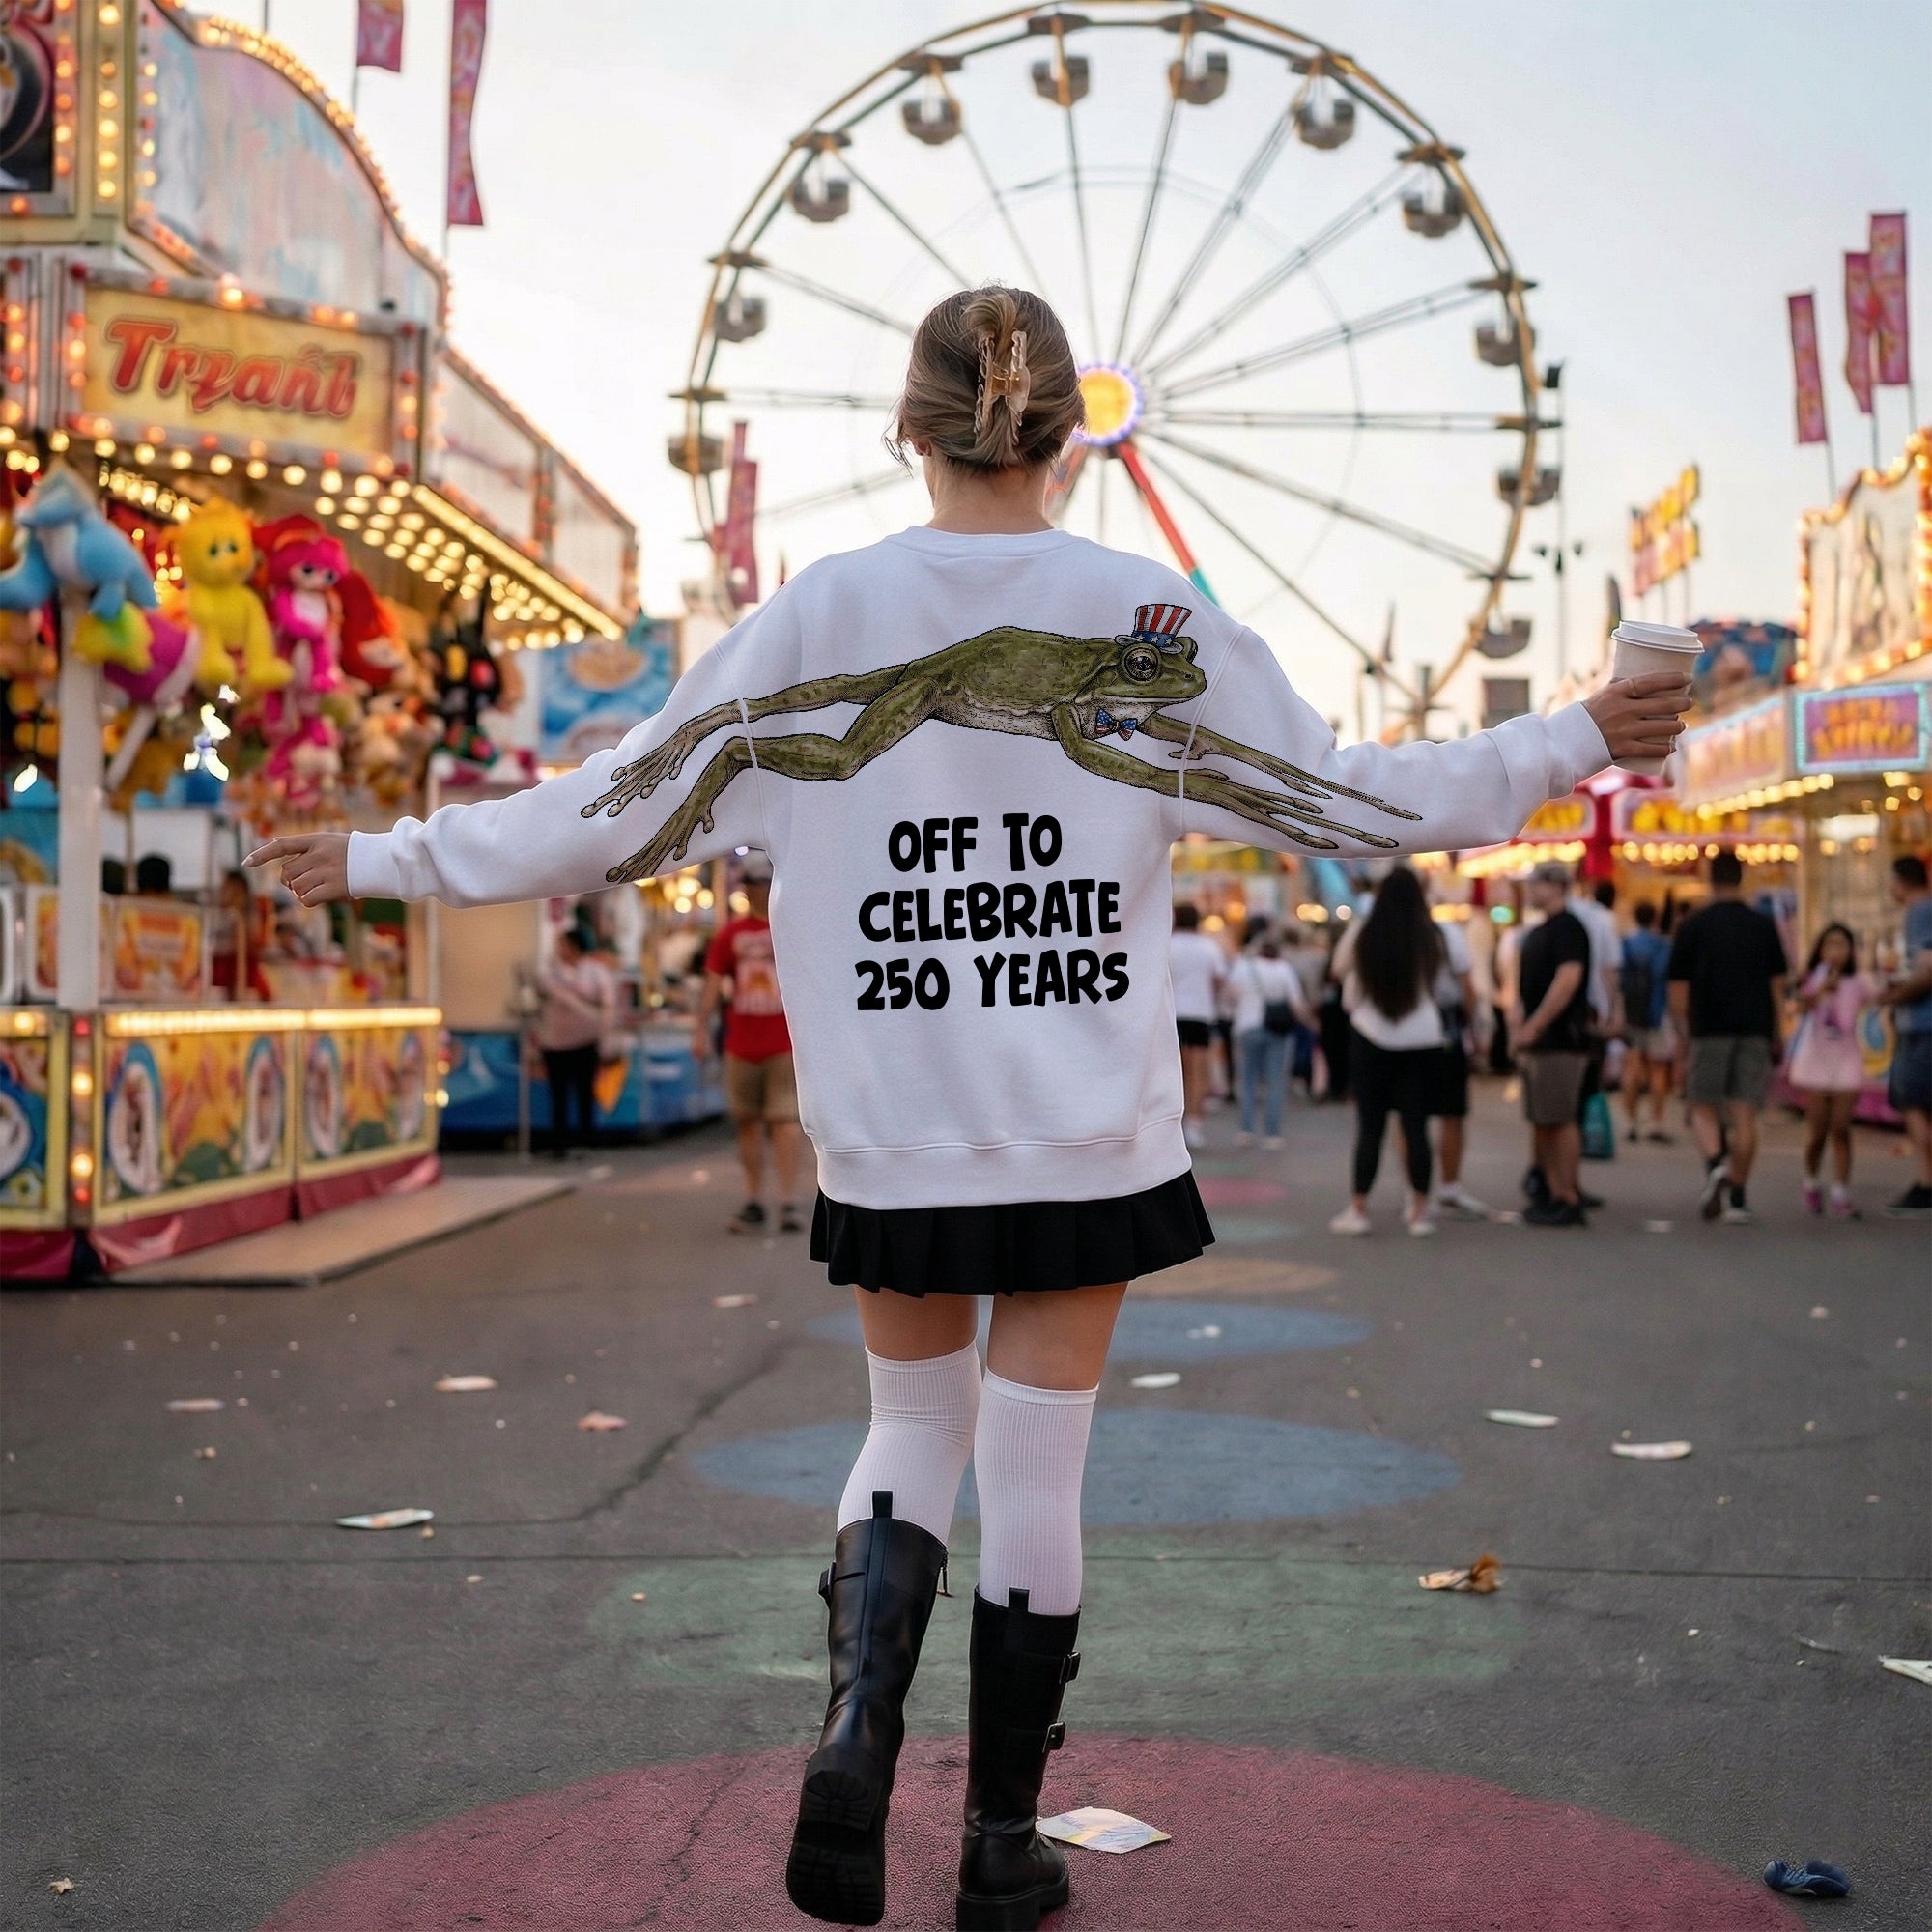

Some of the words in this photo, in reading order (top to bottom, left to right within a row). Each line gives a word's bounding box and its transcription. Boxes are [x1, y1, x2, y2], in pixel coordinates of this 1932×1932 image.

[888, 816, 979, 873] OFF
[1003, 813, 1063, 872] TO
[859, 879, 1122, 943] CELEBRATE
[855, 958, 951, 1011] 250
[974, 949, 1130, 1008] YEARS
